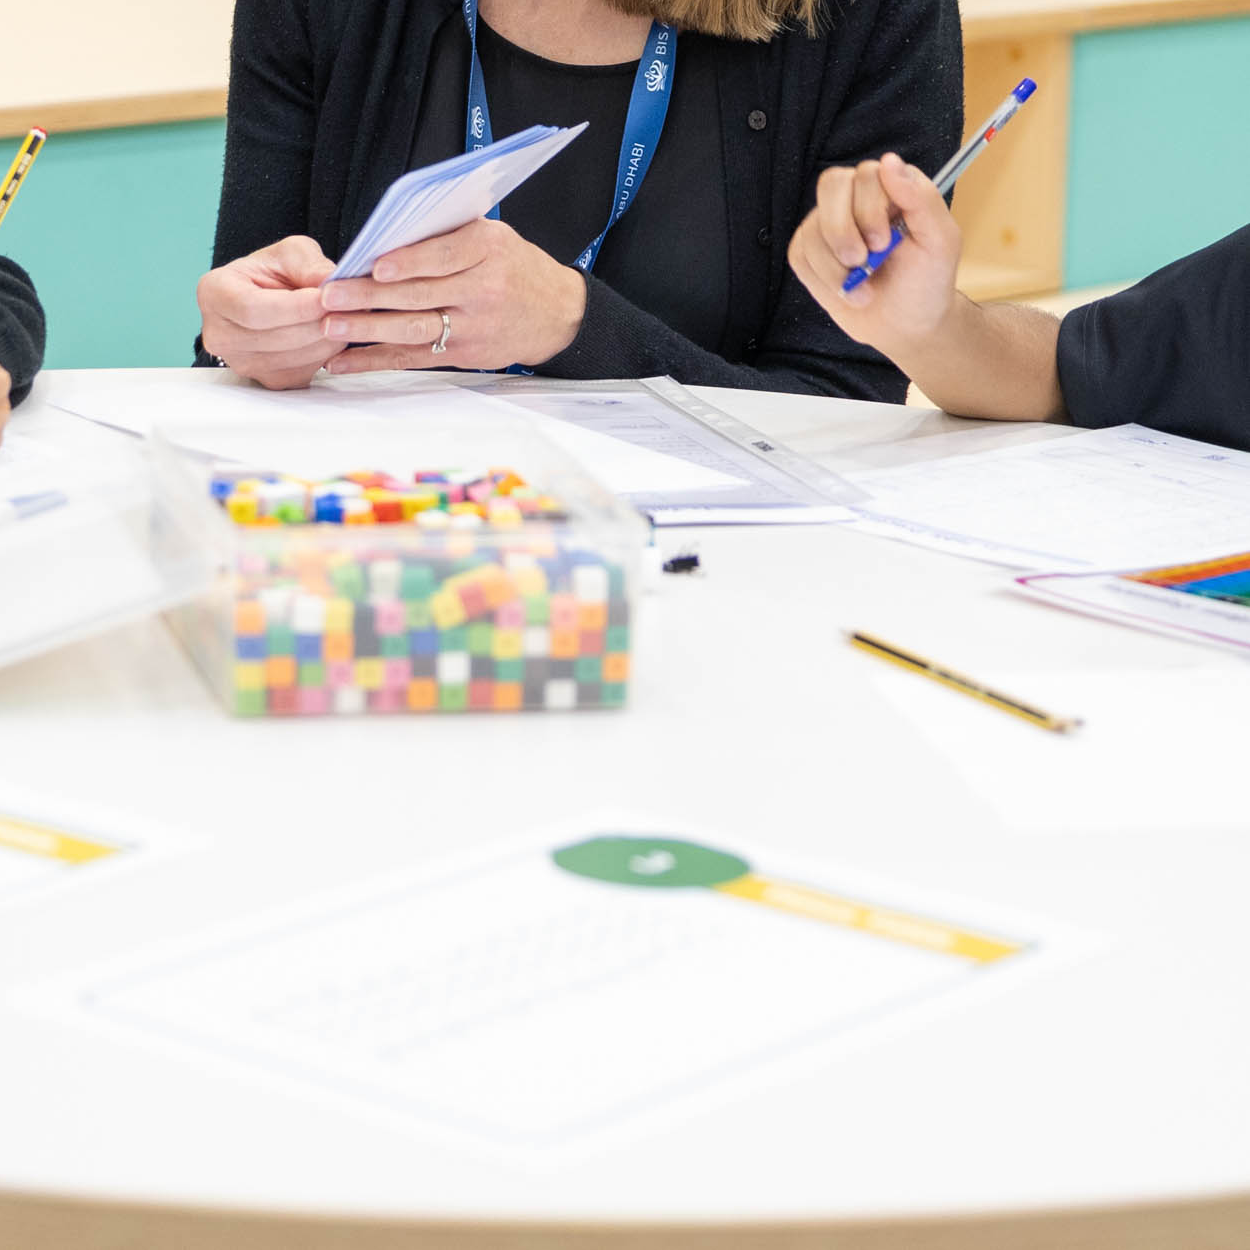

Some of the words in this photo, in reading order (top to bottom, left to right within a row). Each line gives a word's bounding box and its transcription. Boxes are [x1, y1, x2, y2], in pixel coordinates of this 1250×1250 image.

[655, 31, 669, 55] BIS
[616, 190, 629, 219] ABU
[624, 142, 646, 188] DHABI
